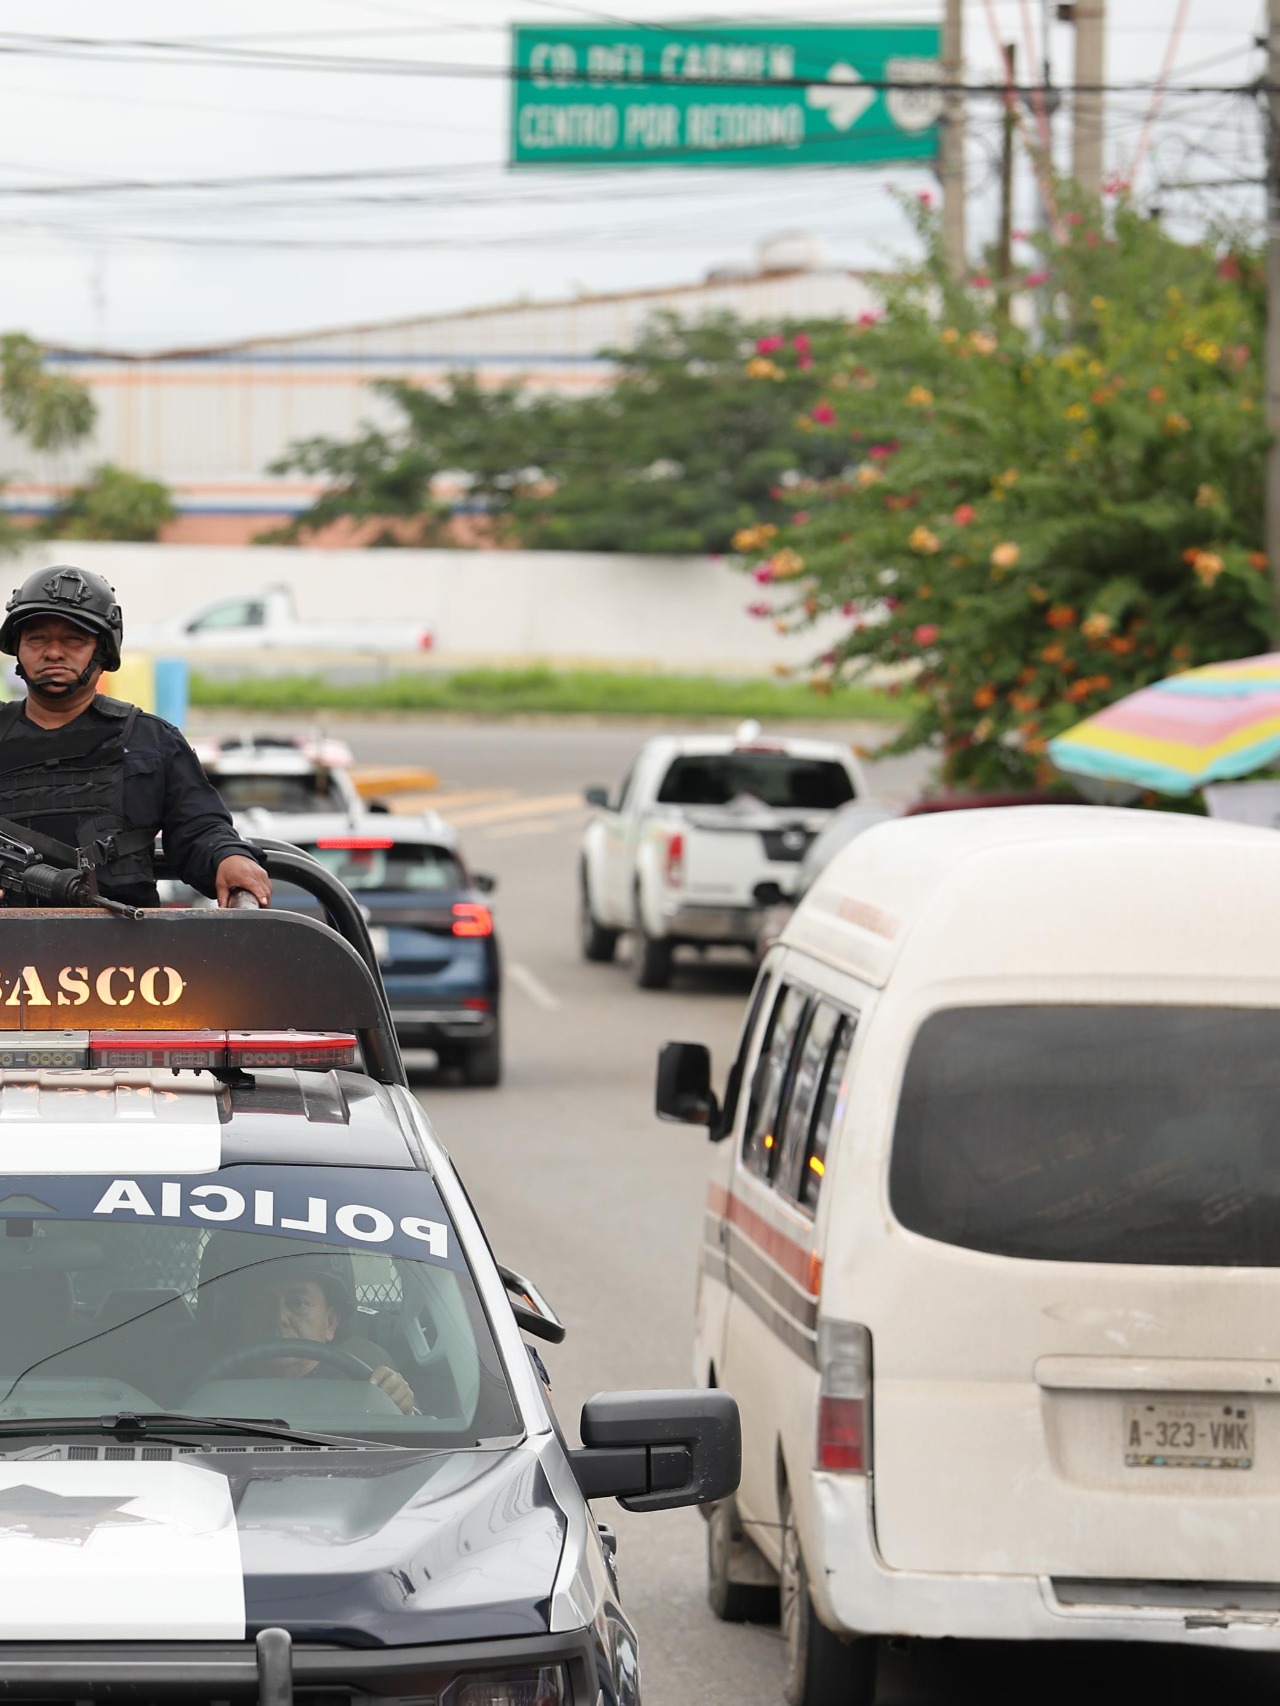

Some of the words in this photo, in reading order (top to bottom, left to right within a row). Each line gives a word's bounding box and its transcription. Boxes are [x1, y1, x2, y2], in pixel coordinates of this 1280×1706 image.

[519, 103, 618, 148] CENTRO
[624, 103, 679, 148] POR
[686, 103, 804, 149] RETORNO
[1128, 1420, 1249, 1449] A-323-VMK
